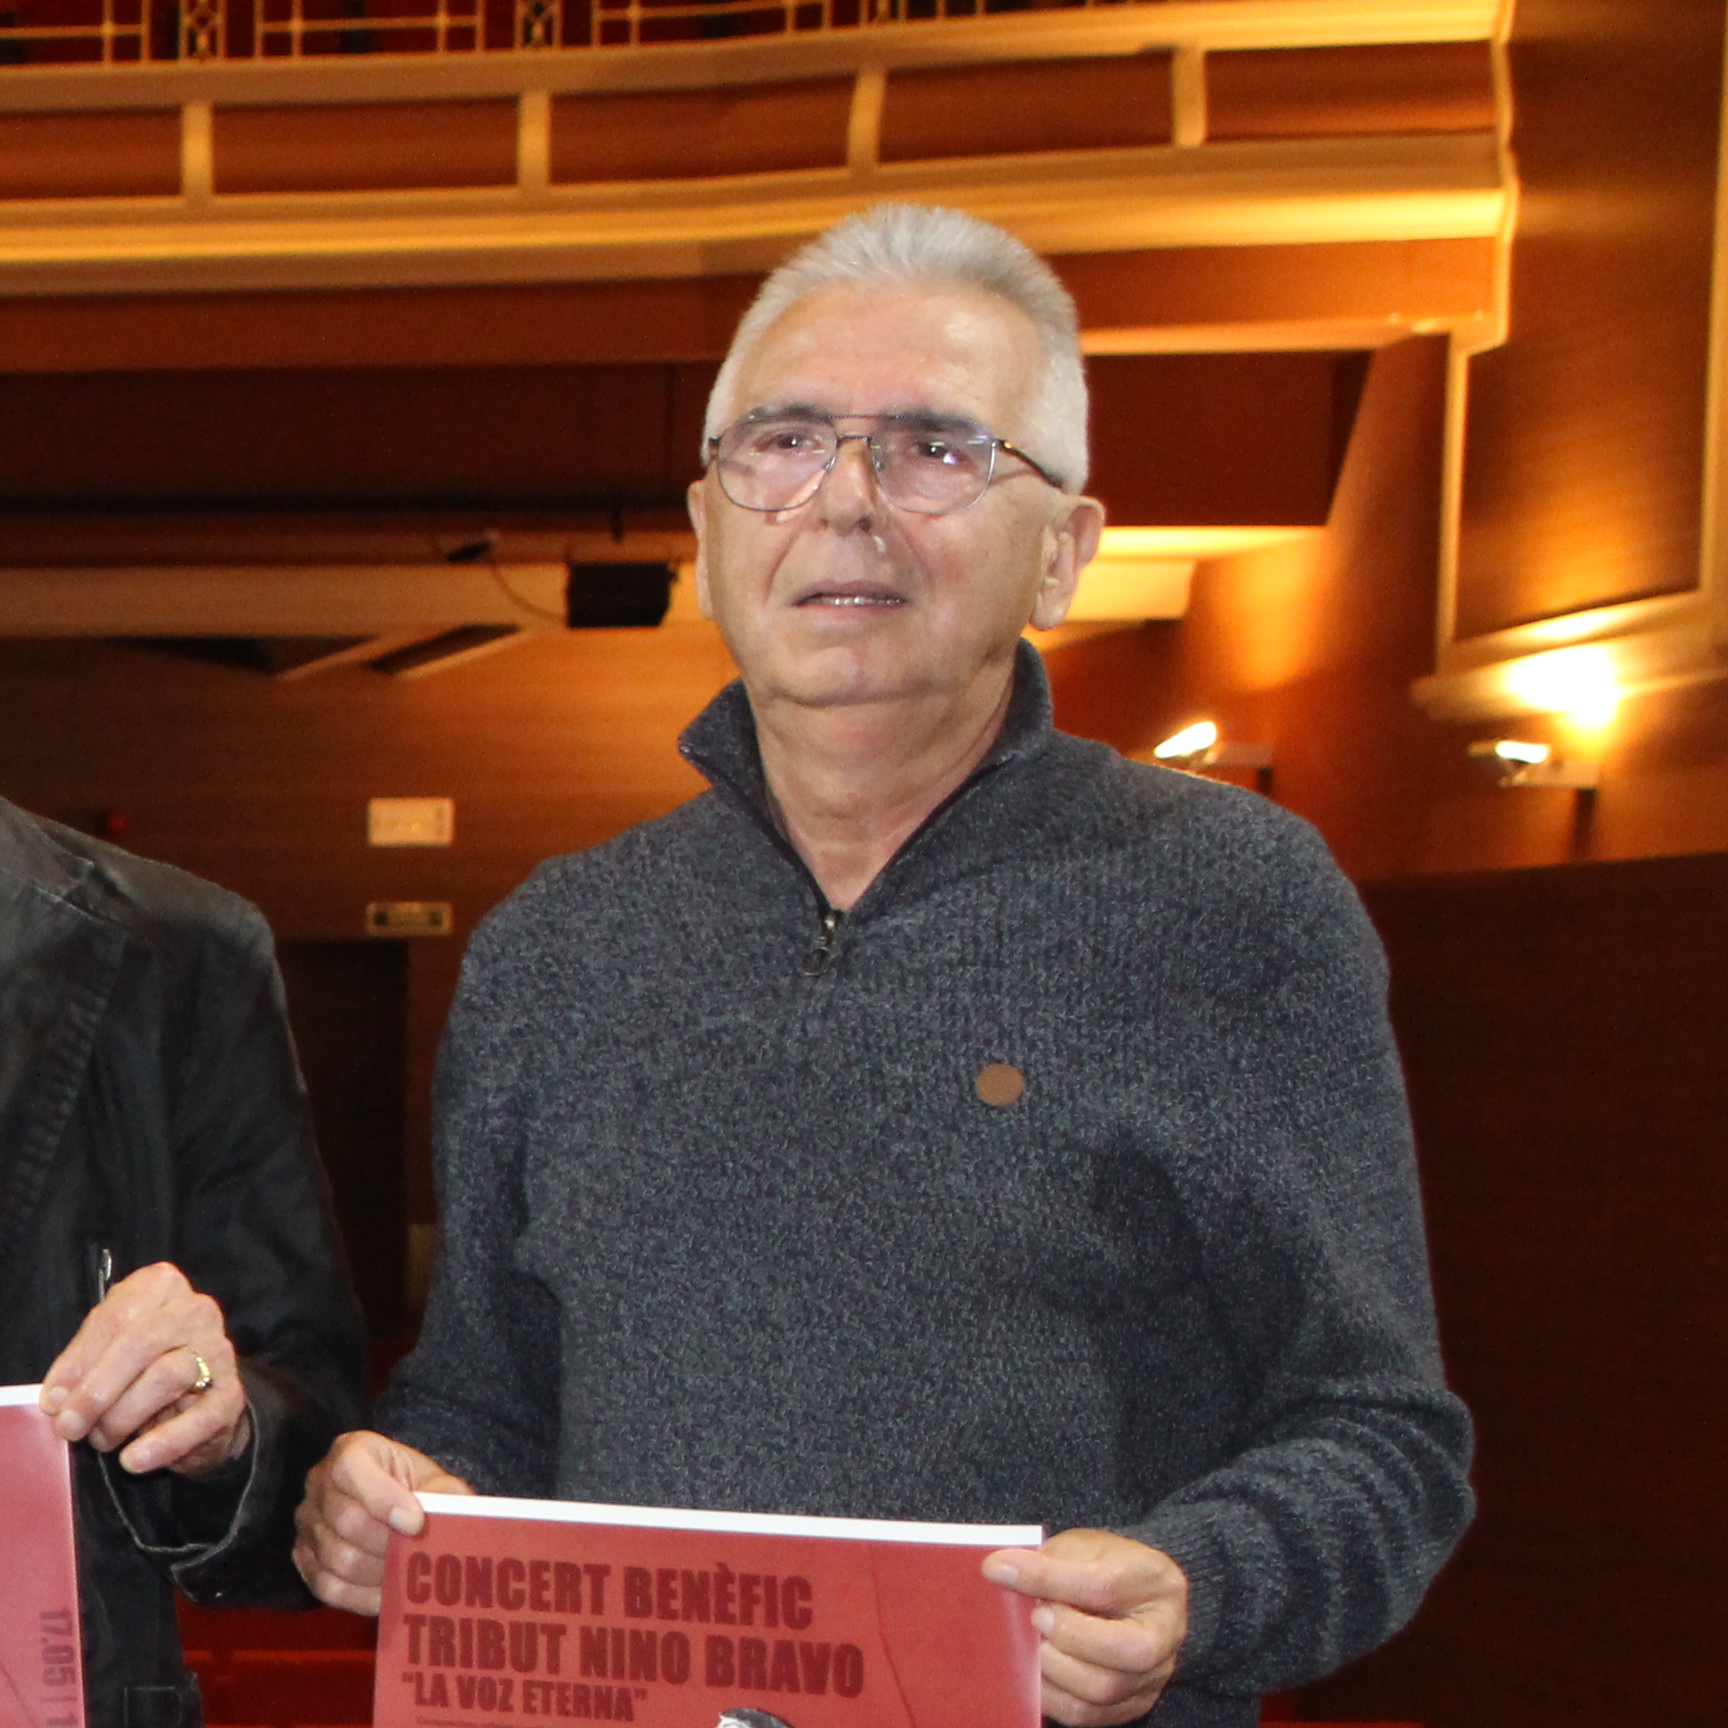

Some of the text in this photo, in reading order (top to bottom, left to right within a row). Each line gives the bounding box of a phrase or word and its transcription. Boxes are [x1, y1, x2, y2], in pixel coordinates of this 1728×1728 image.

[406, 1550, 611, 1616] CONCERT
[403, 1613, 864, 1699] TRIBUT NINO BRAVO
[456, 1675, 513, 1712] VOZ
